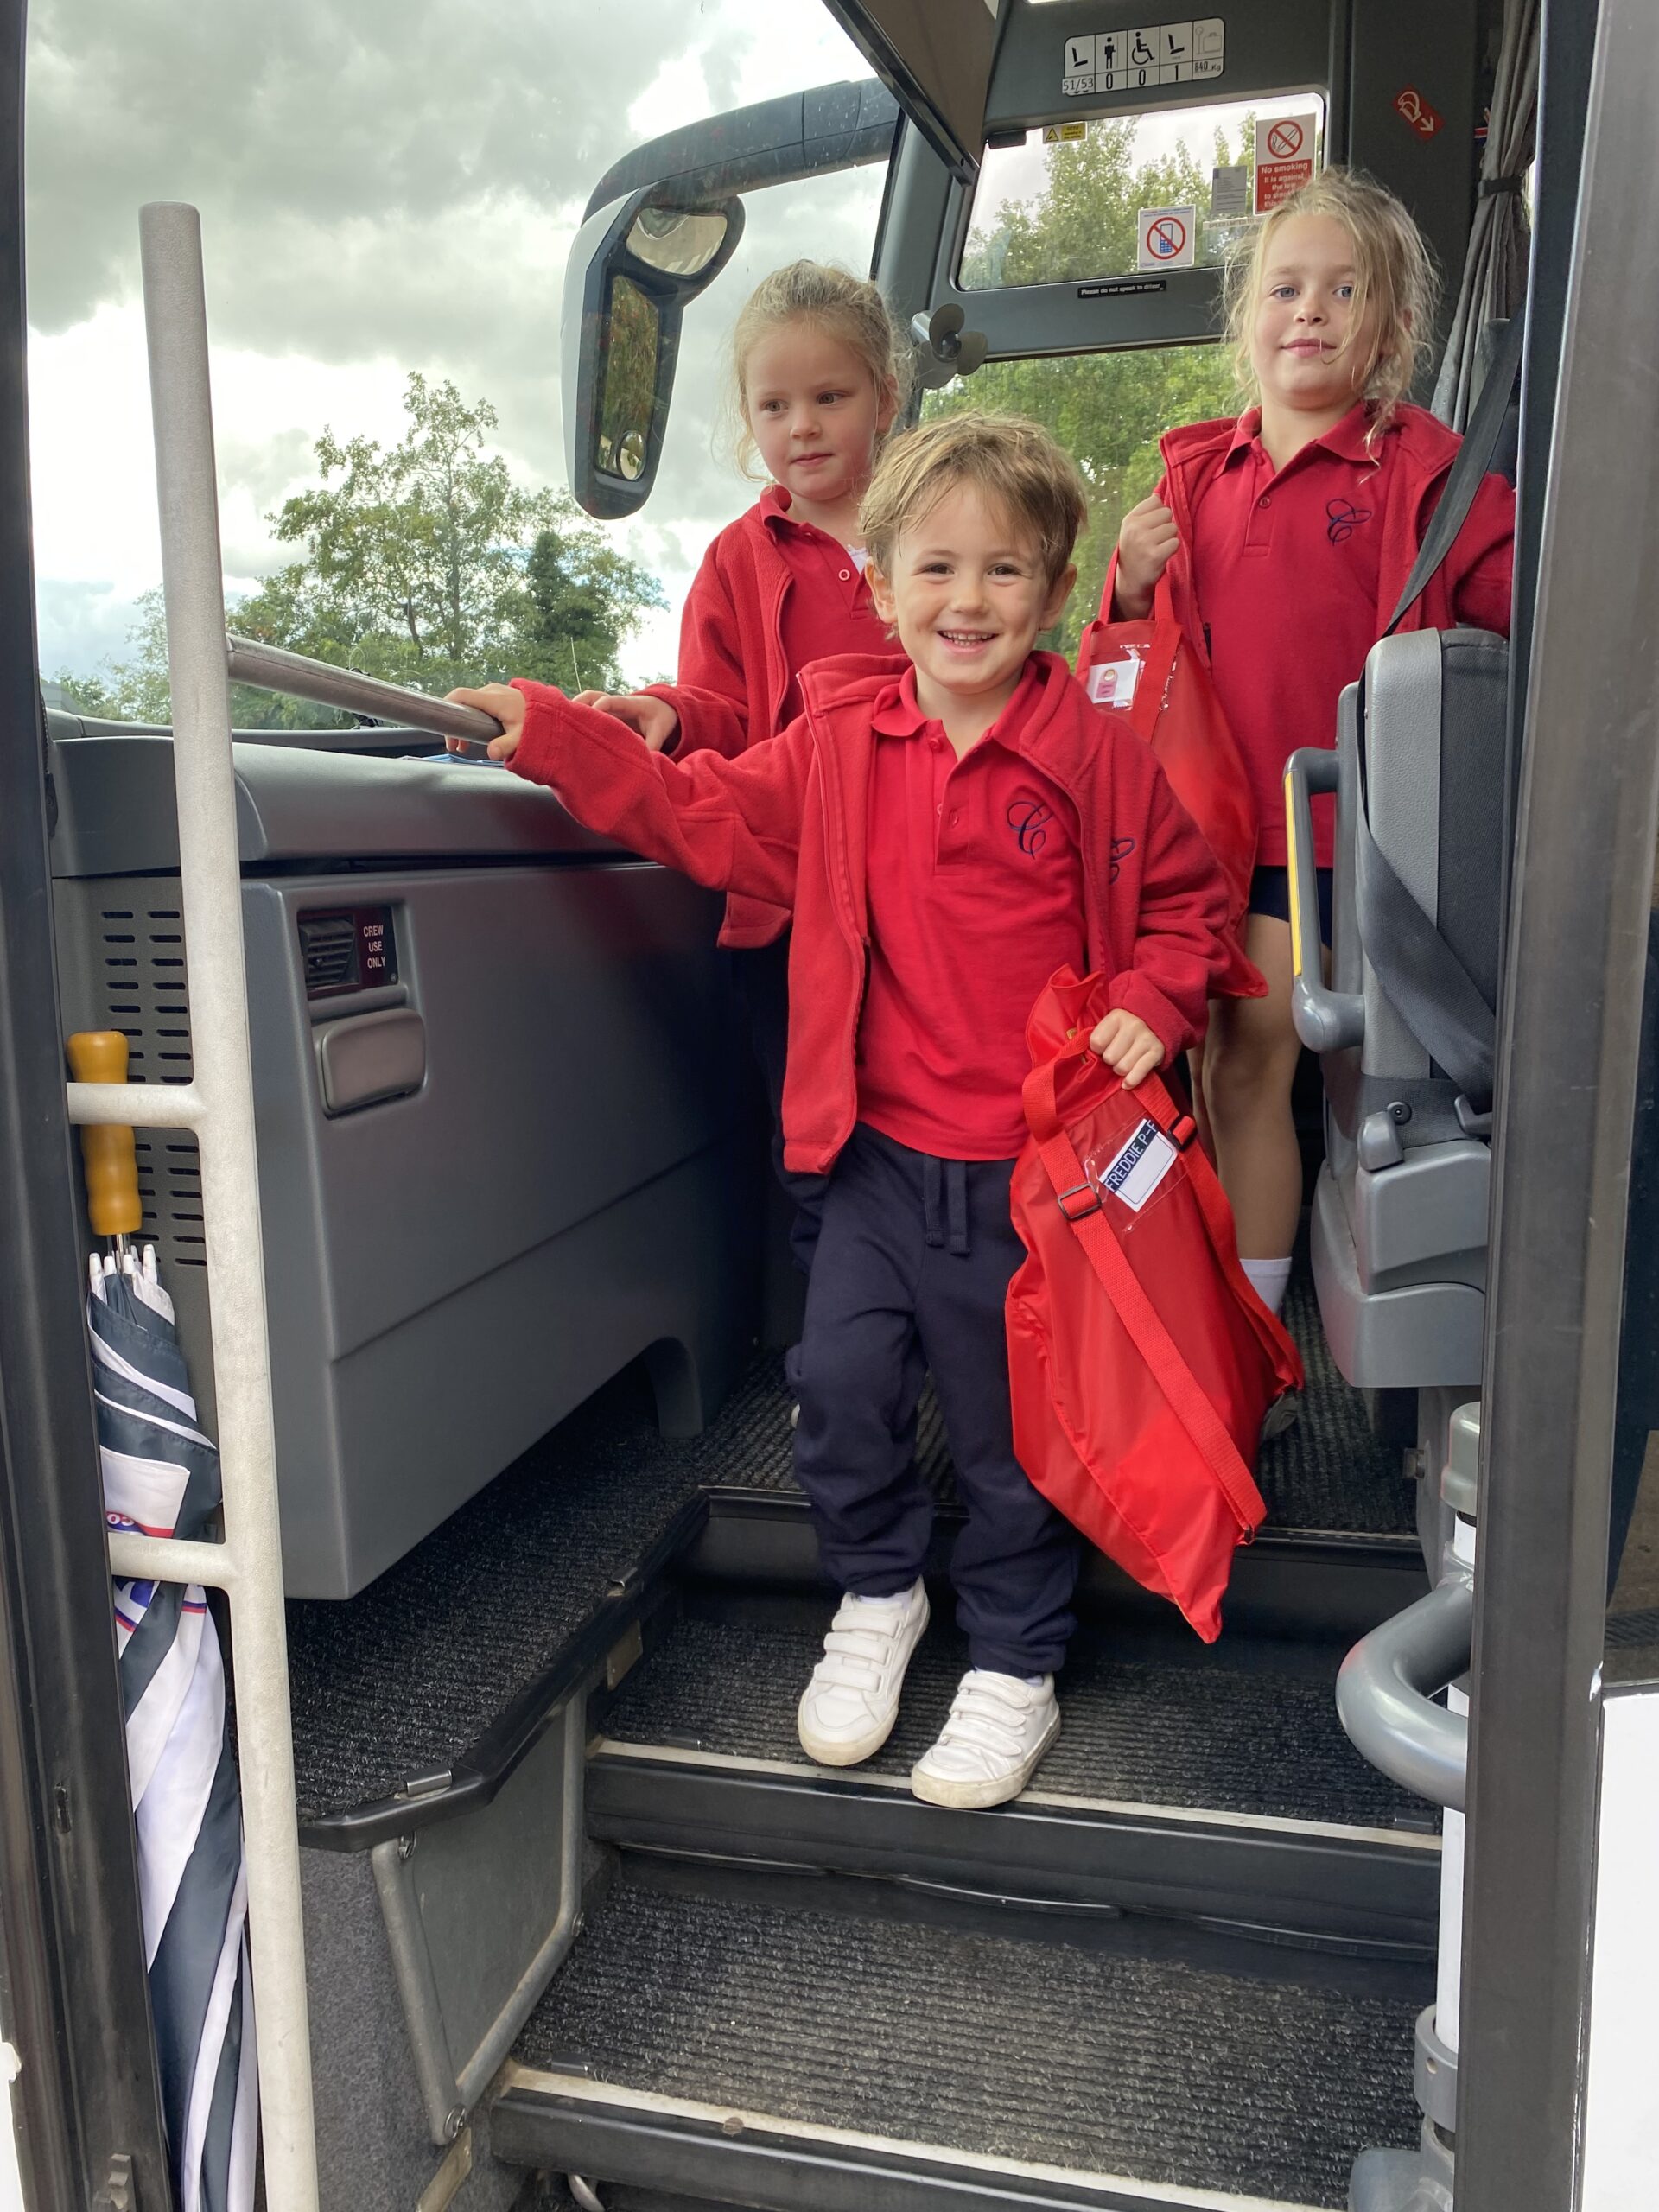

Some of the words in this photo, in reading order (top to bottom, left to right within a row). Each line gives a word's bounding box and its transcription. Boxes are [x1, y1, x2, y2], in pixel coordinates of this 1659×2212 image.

[1063, 78, 1094, 91] 51/53
[1106, 73, 1113, 89] 0
[1138, 69, 1147, 86] 0
[1274, 162, 1308, 173] smoking
[364, 925, 384, 937] CREW
[368, 941, 383, 952] USE
[367, 957, 386, 968] ONLY
[1103, 1141, 1145, 1192] FREDDIE
